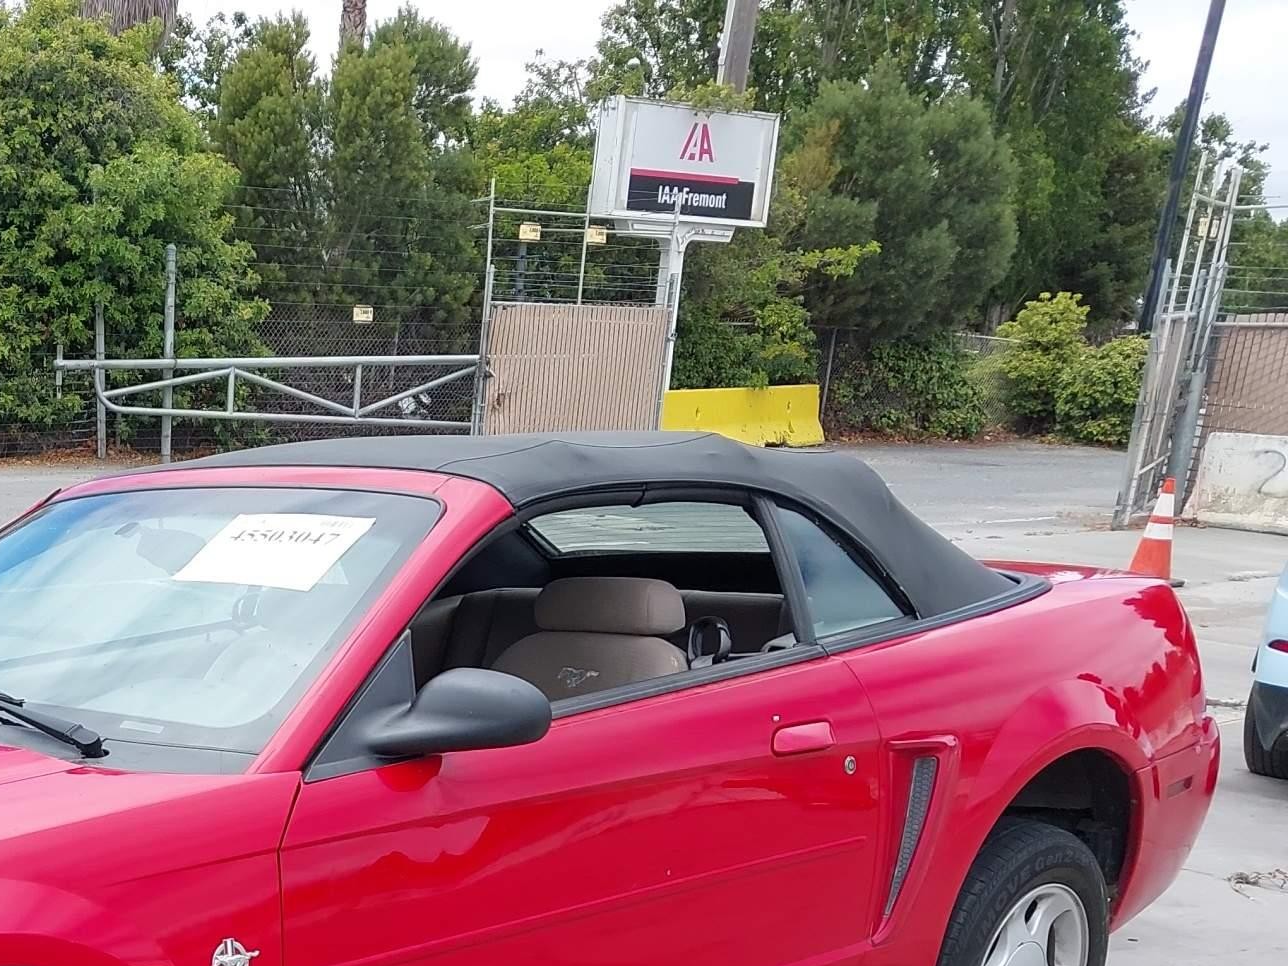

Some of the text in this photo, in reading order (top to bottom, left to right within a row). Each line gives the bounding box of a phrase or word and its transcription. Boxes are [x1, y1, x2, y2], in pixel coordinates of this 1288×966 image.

[658, 185, 727, 209] IAA Fremont
[230, 529, 342, 545] 45503047
